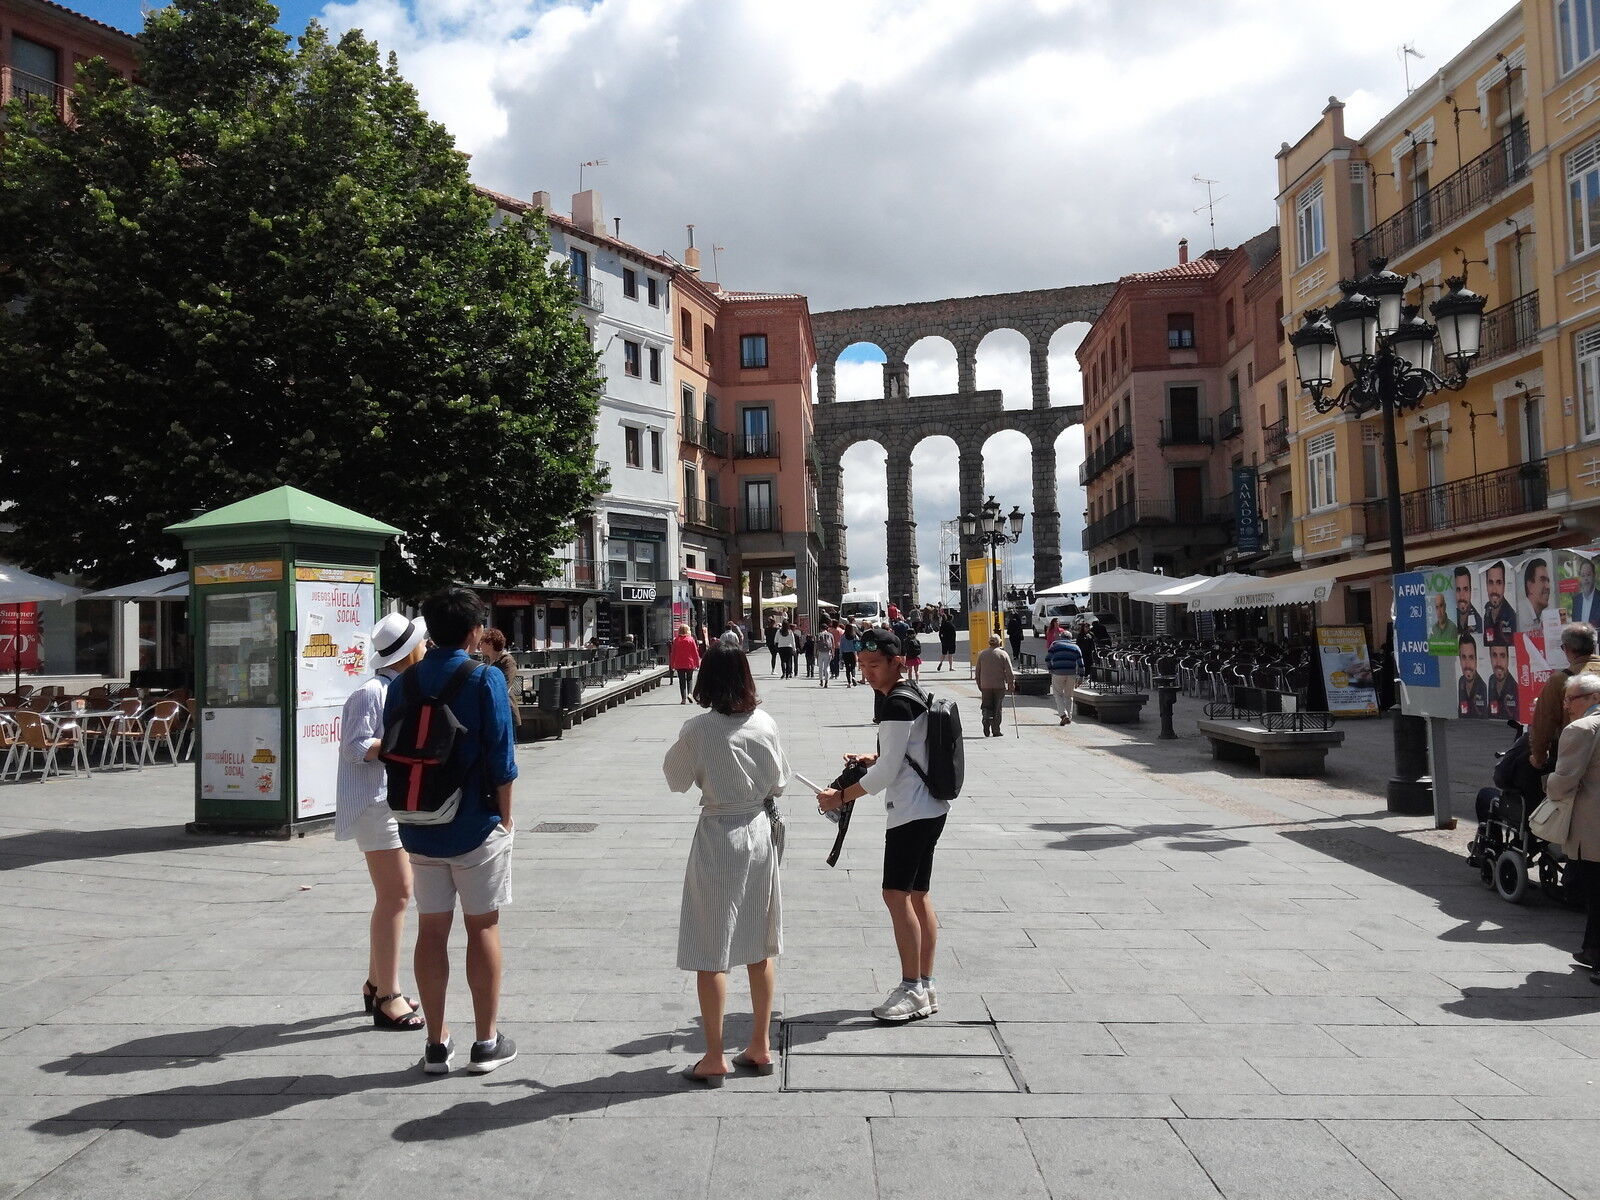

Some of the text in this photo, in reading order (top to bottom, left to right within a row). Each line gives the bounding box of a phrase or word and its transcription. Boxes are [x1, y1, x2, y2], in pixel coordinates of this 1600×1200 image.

[1239, 483, 1252, 525] AMADO
[331, 588, 360, 607] HUELLA
[1399, 584, 1426, 597] A FAVO
[336, 610, 360, 627] SOCIAL
[1401, 641, 1408, 653] A
[1408, 641, 1430, 653] FAVO
[303, 723, 329, 738] JUEGOS
[221, 749, 245, 765] HUELLA
